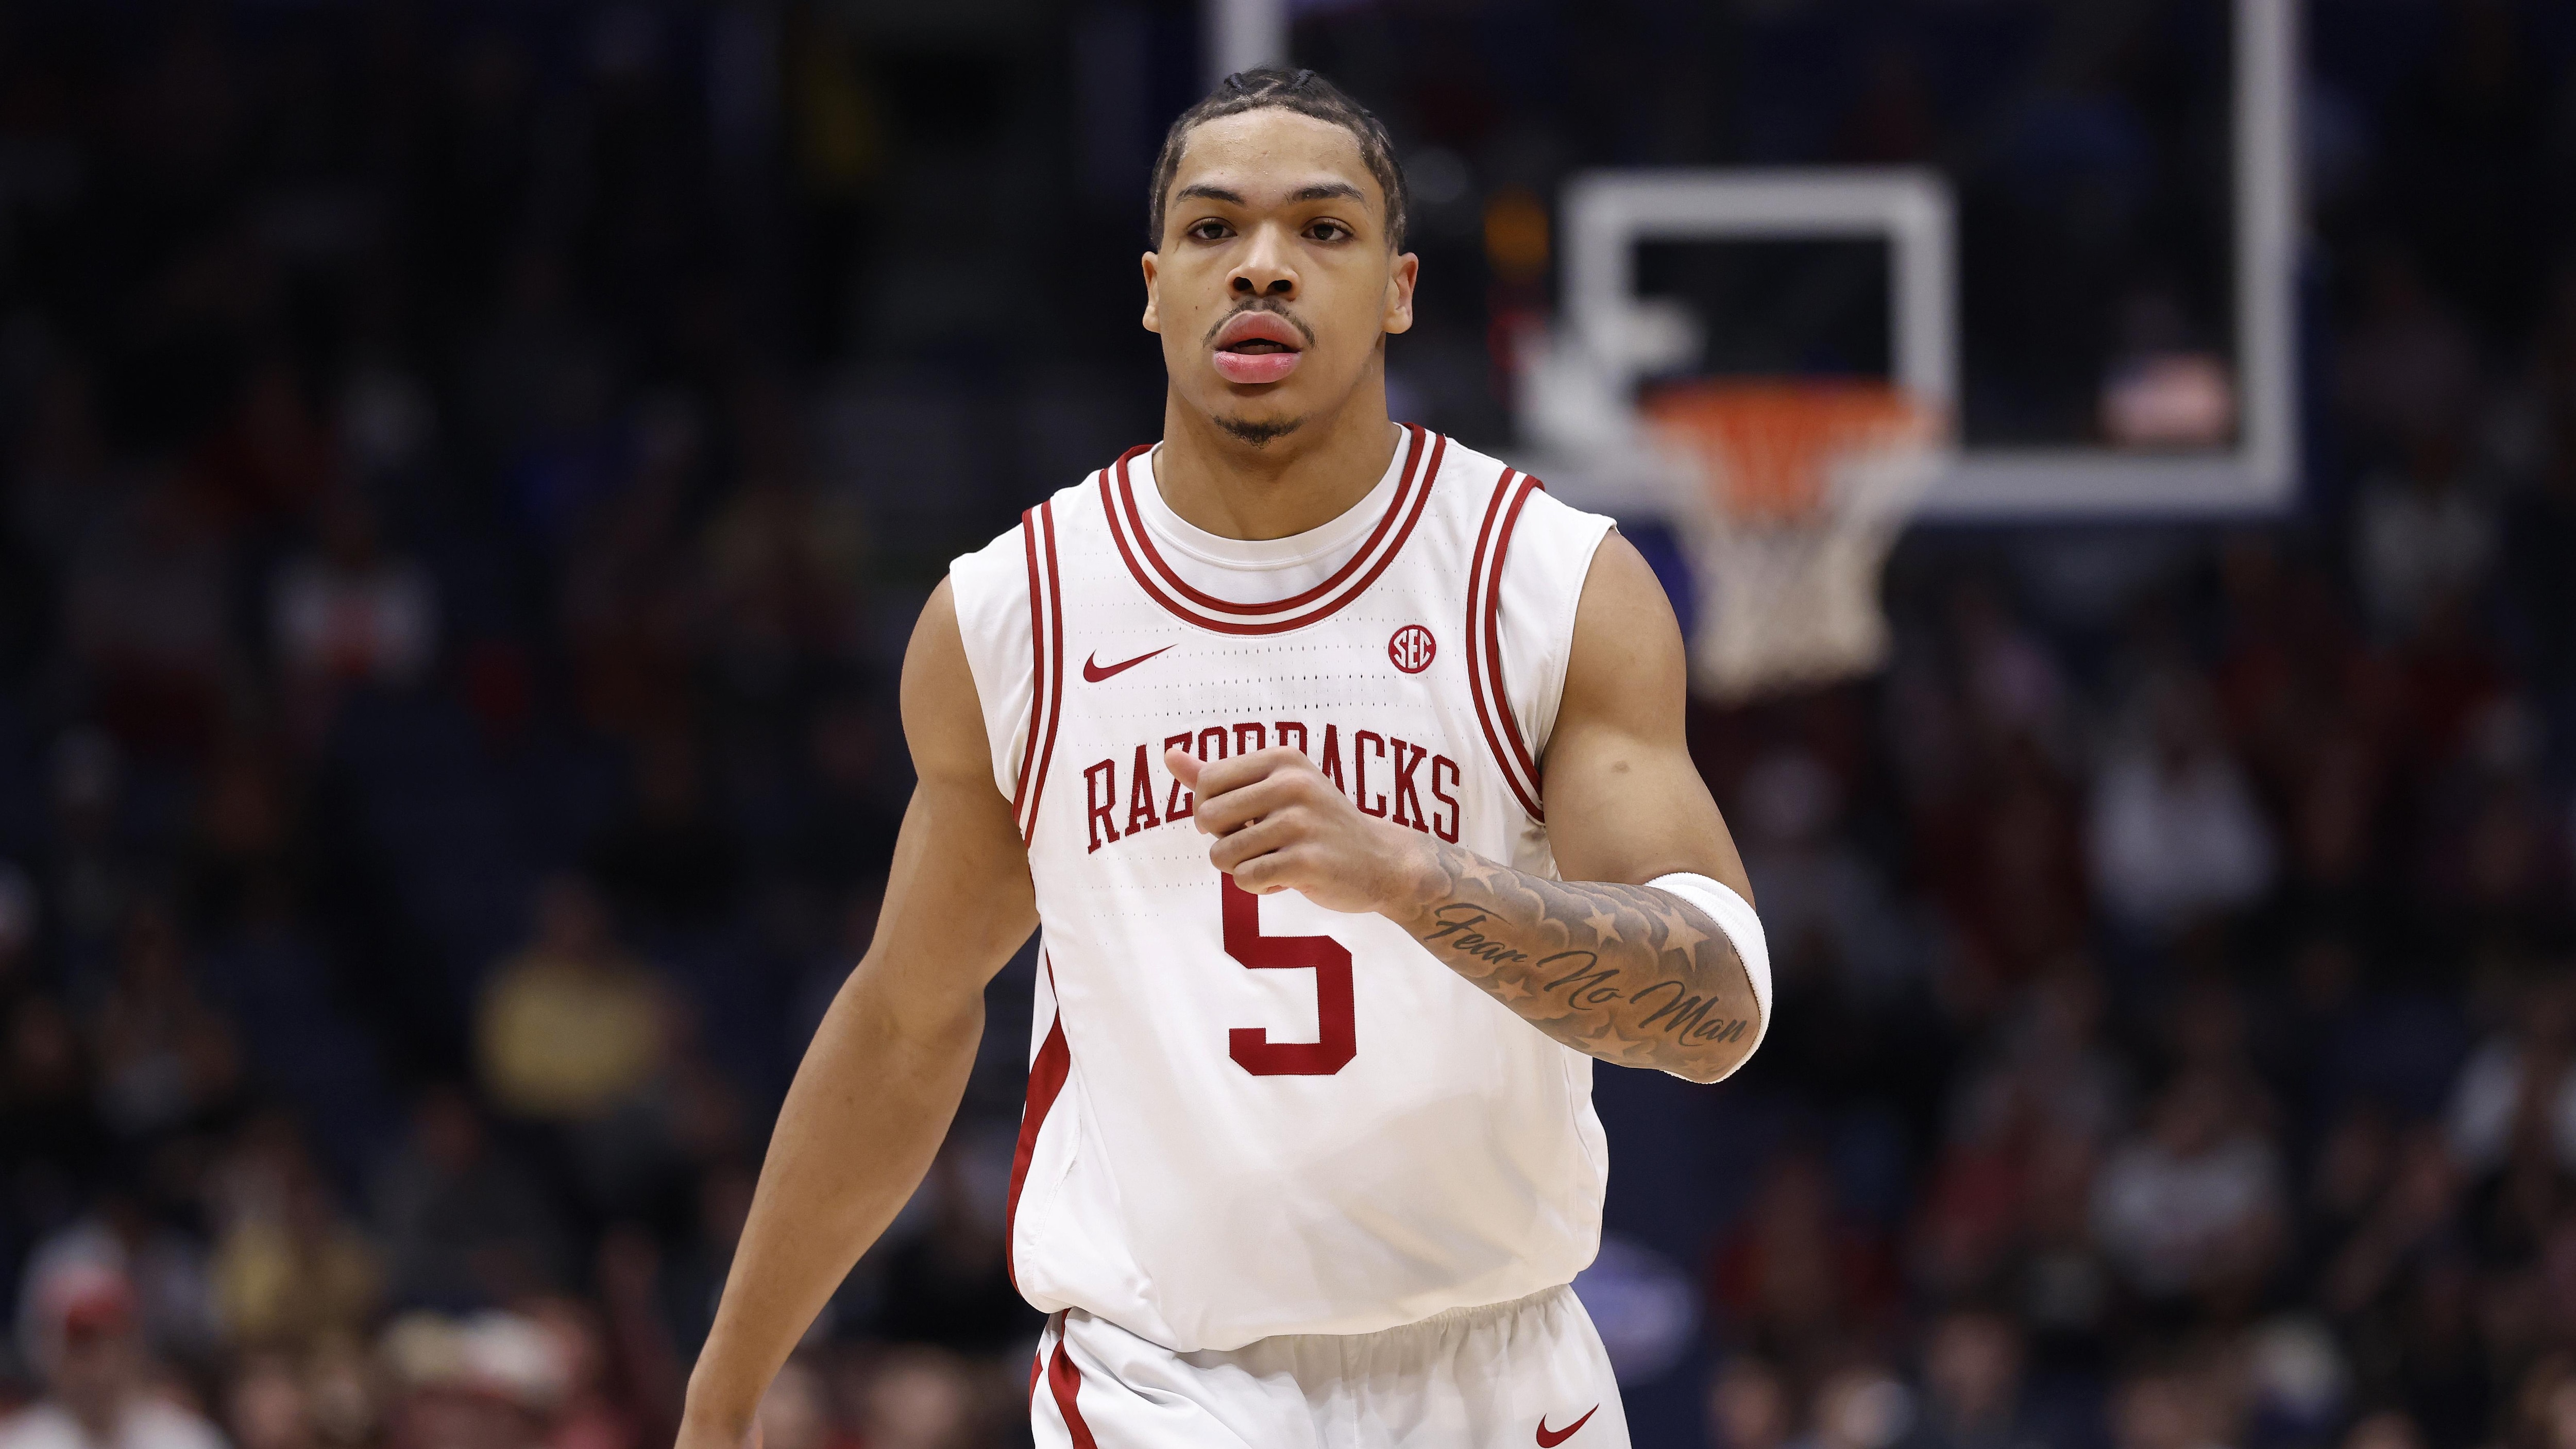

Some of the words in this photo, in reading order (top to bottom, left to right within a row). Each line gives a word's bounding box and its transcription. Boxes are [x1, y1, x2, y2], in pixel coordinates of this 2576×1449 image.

[1393, 628, 1432, 669] SEC
[1222, 870, 1357, 1076] 5
[1423, 902, 1529, 965] Fear
[1536, 950, 1625, 1011] No
[1629, 981, 1748, 1047] Man
